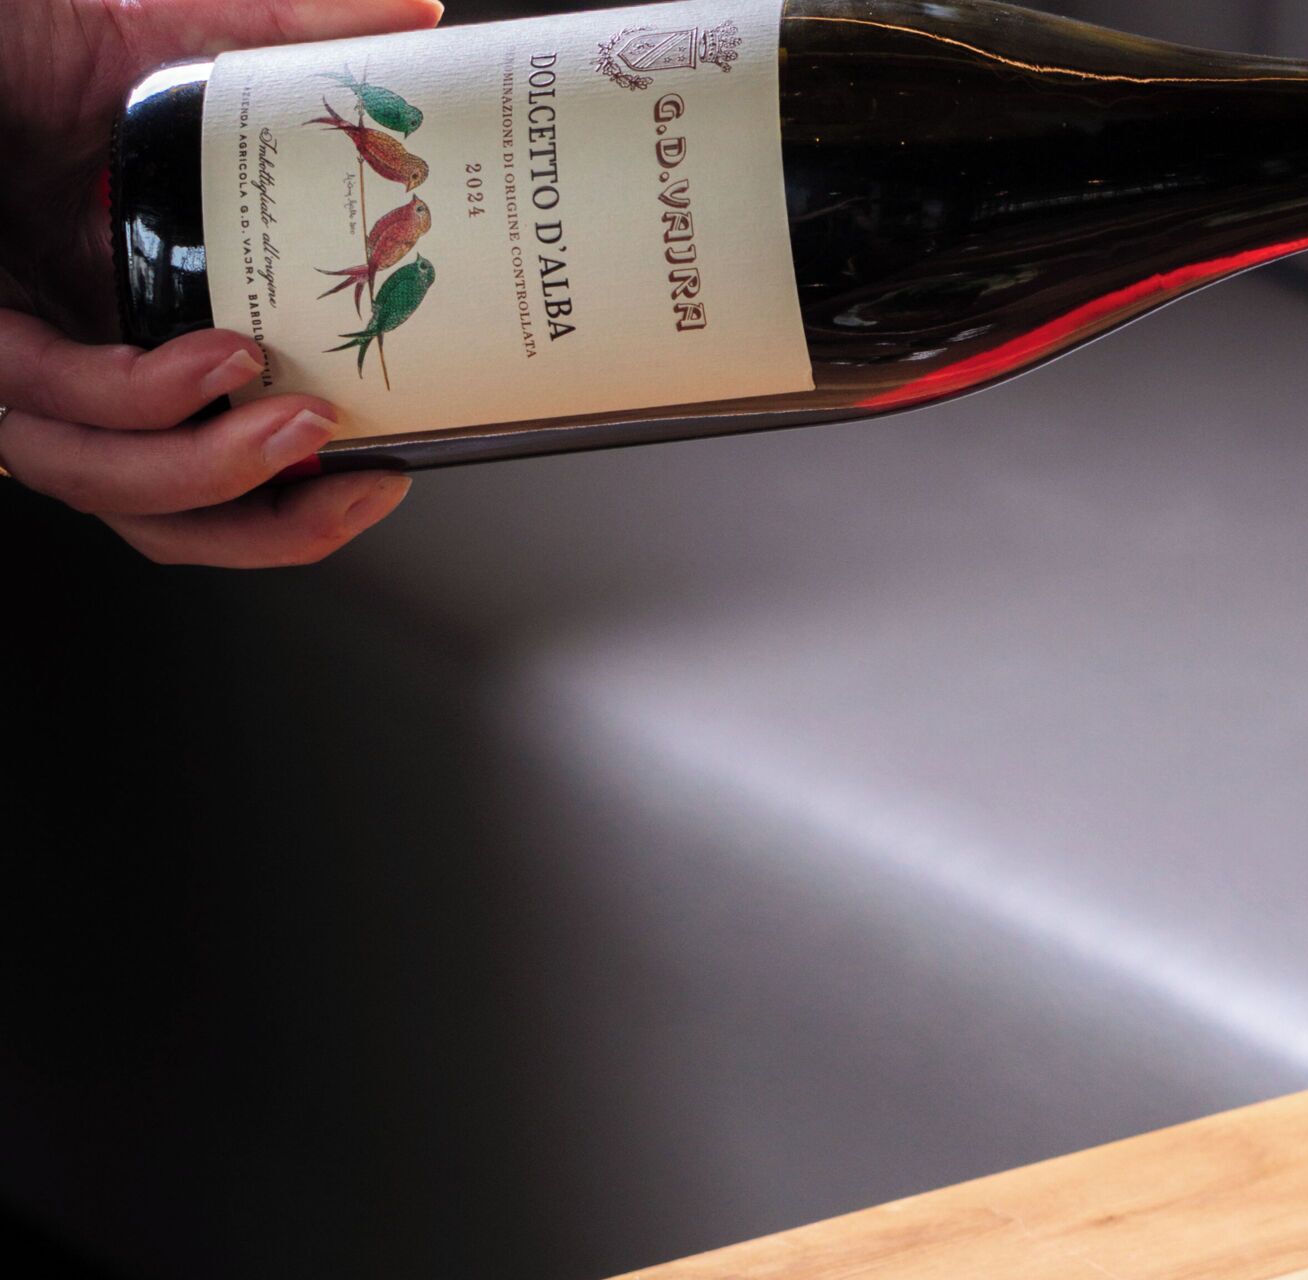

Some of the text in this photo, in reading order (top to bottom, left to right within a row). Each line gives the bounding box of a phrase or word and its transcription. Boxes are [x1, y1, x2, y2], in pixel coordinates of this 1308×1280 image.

[503, 153, 514, 169] DI
[528, 53, 560, 210] DOLCETTO
[238, 134, 248, 198] AGRICOLA
[250, 127, 278, 228] Imbottigliato
[465, 162, 487, 219] 2024
[240, 205, 250, 234] G.D.
[504, 173, 520, 241] ORIGINE
[242, 238, 255, 285] VAJRA
[511, 246, 537, 358] CONTROLLATA
